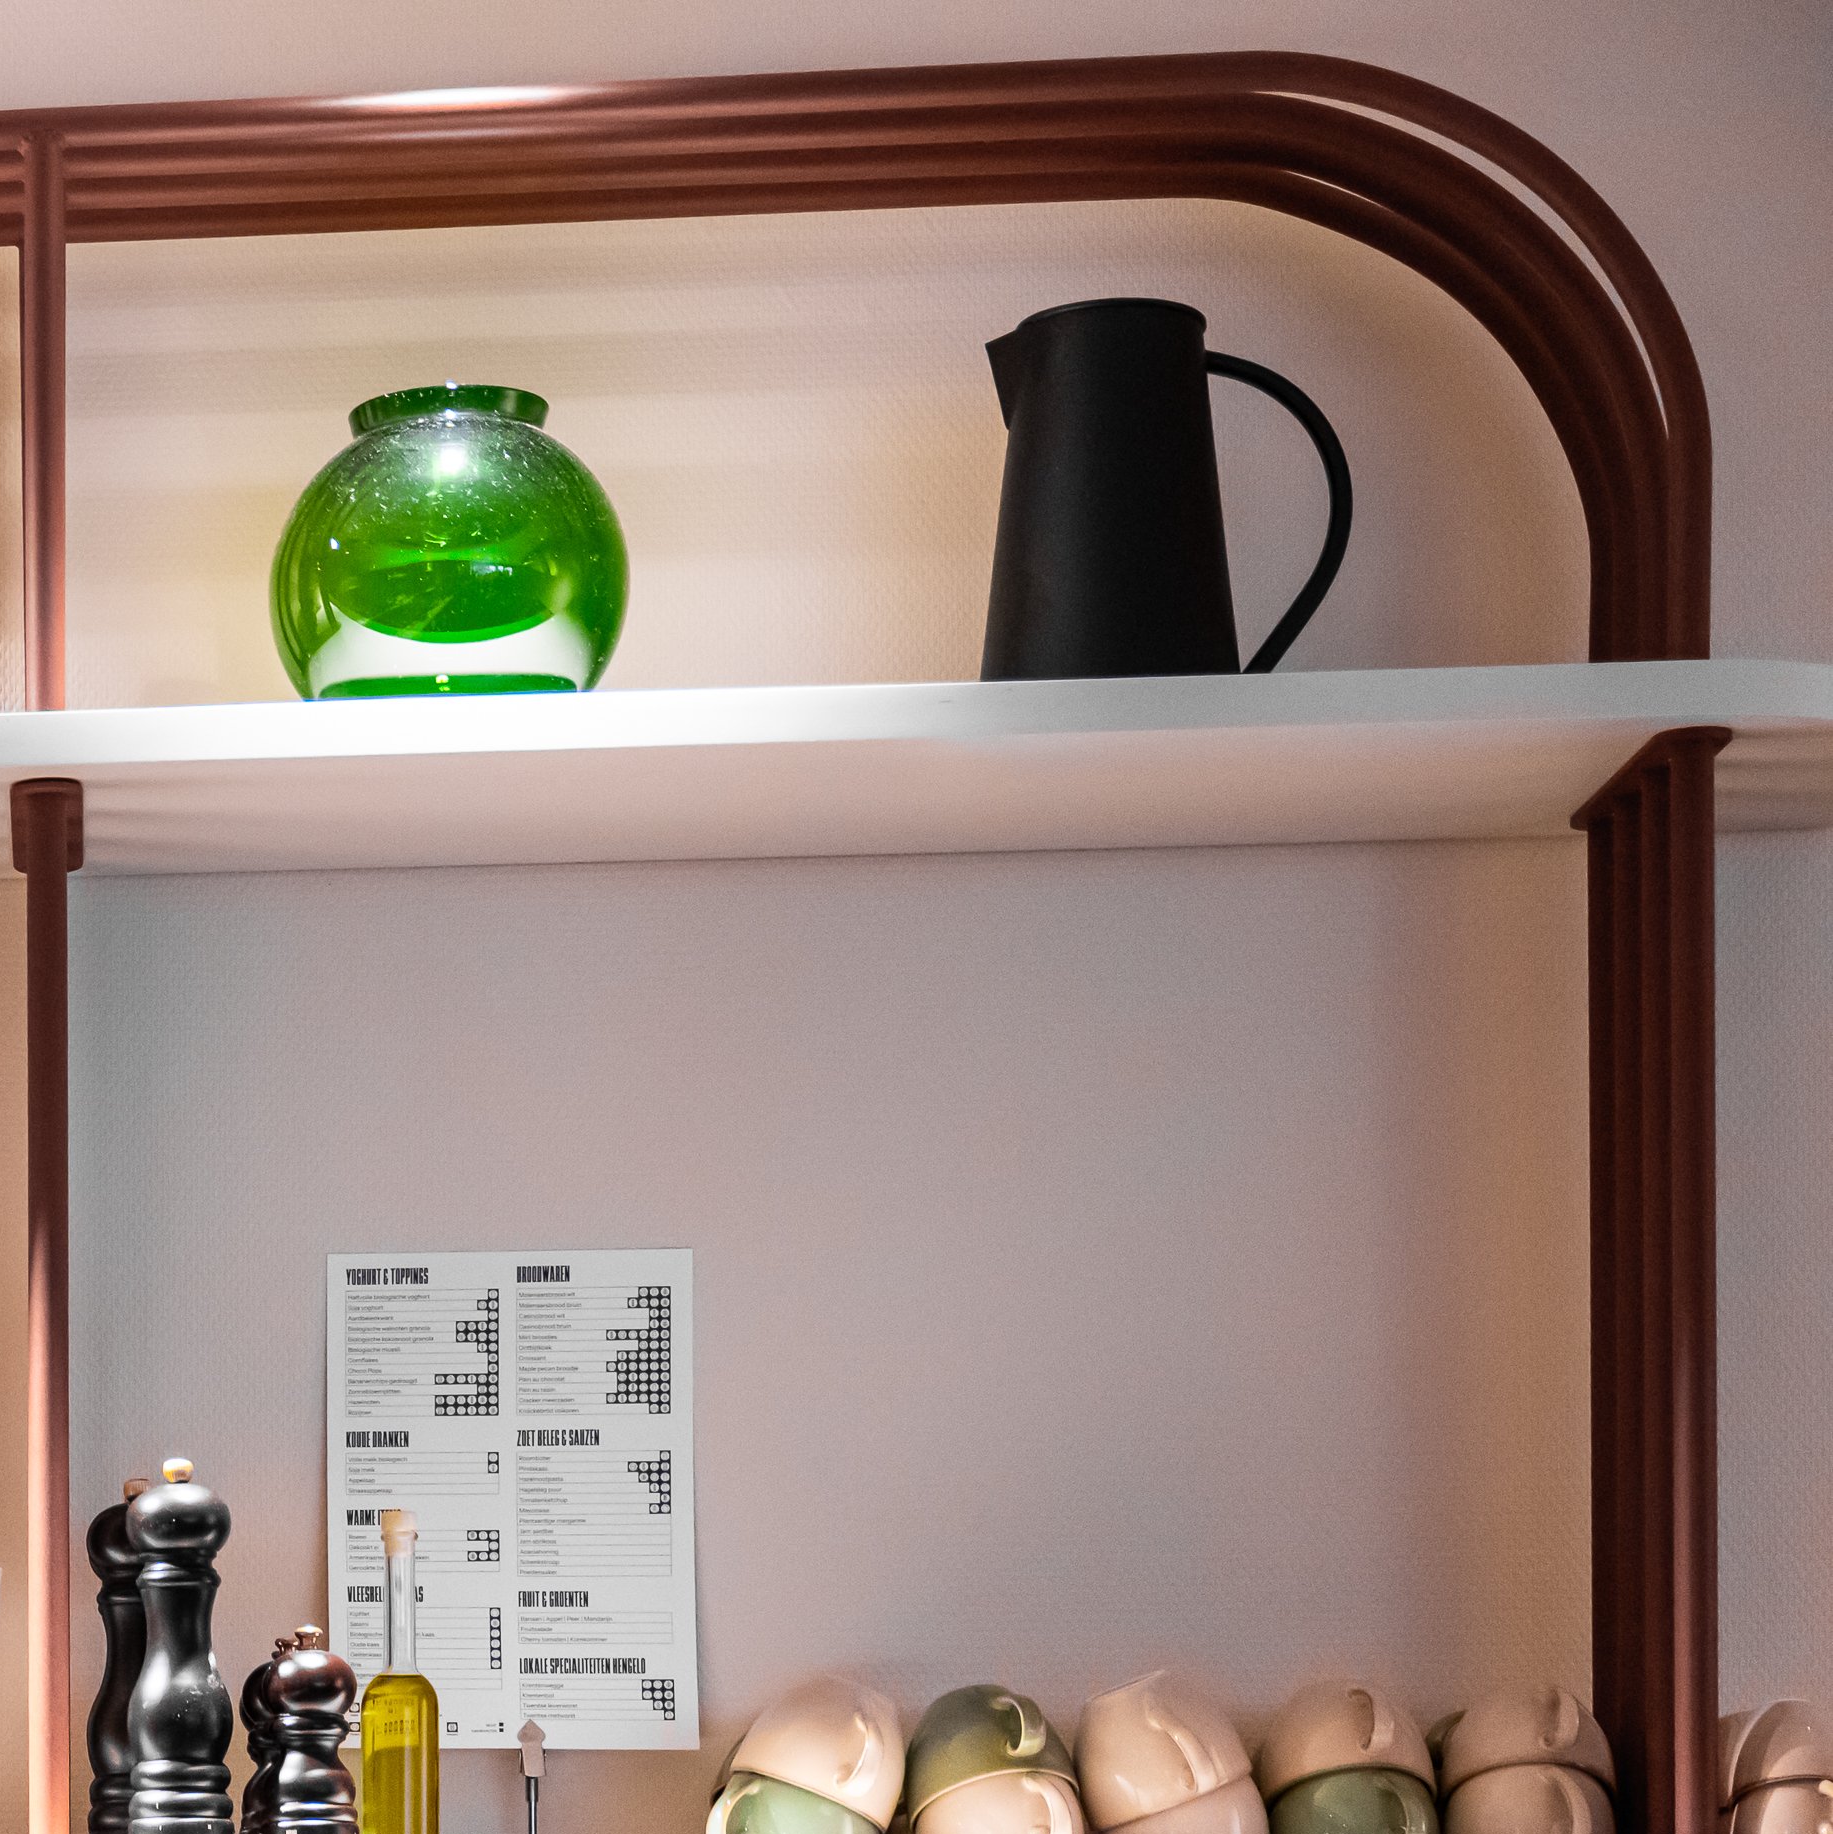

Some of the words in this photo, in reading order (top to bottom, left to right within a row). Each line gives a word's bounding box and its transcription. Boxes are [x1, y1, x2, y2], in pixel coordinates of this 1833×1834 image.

[346, 1269, 381, 1285] YOGHURT
[391, 1268, 429, 1285] TOPPINGS
[517, 1266, 570, 1283] BROODWAREN
[346, 1432, 370, 1448] KOUDE
[373, 1431, 409, 1448] DRANKEN
[517, 1430, 535, 1446] ZOET
[538, 1430, 559, 1446] BELEG
[569, 1429, 599, 1446] SAUZEN
[347, 1510, 375, 1525] WARME
[347, 1586, 384, 1602] VLEESBEL
[519, 1591, 539, 1607] FRUIT
[550, 1591, 588, 1607] GROENTEN
[520, 1658, 547, 1674] LOKALE
[550, 1658, 610, 1674] SPECIALITEITEN
[613, 1658, 646, 1674] HENGELO
